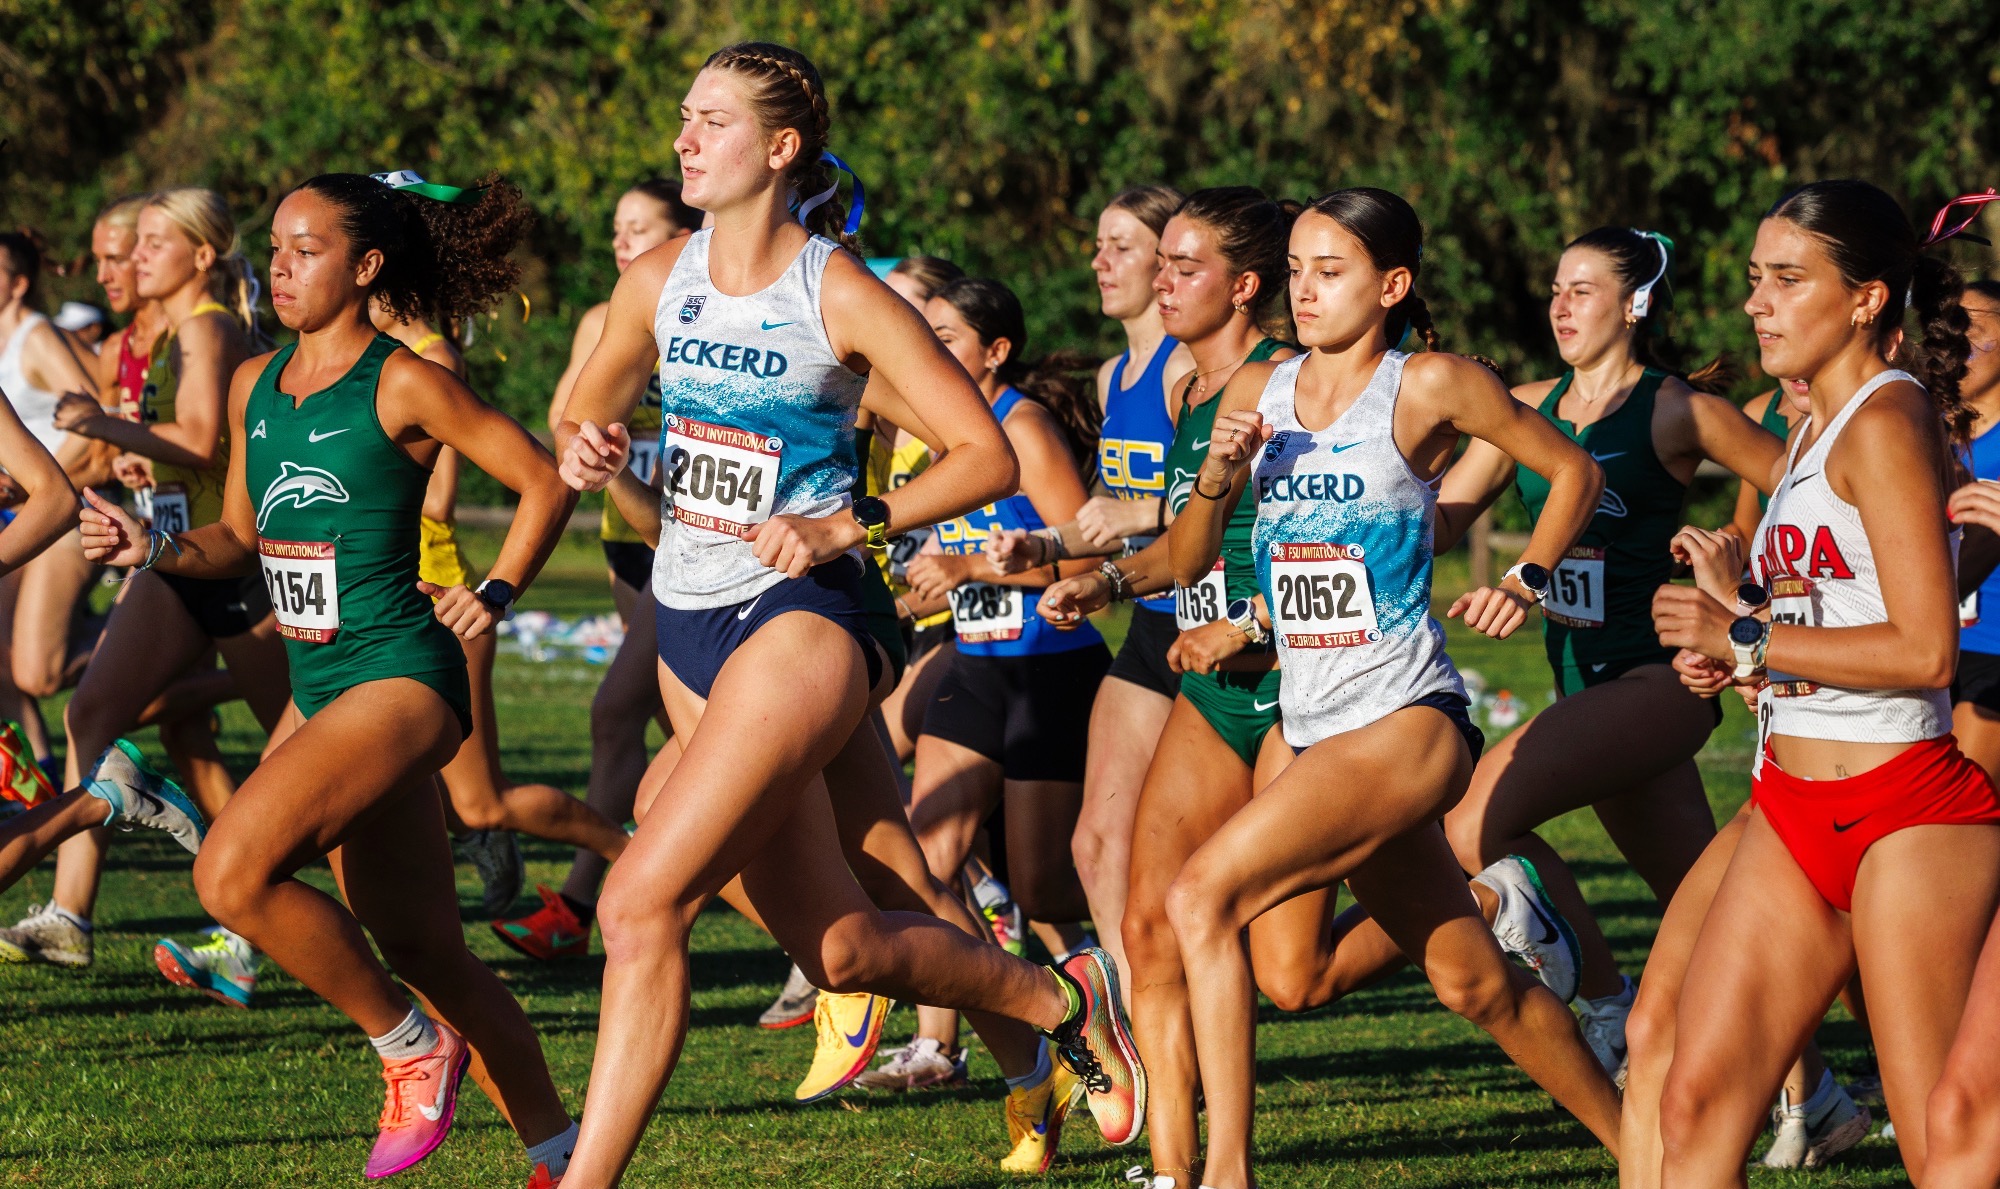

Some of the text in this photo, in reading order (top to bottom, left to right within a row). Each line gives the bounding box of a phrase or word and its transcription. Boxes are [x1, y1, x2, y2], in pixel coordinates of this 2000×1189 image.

[688, 297, 704, 305] SSC
[666, 337, 787, 379] ECKERD
[689, 423, 705, 437] FSU
[1098, 437, 1165, 490] SC
[671, 448, 762, 511] 2054
[1259, 473, 1365, 503] ECKERD
[676, 507, 748, 536] FLORIDA STATE
[264, 542, 324, 557] FSU INVITATIONAL
[1288, 546, 1300, 558] FSU
[265, 567, 326, 615] 2154
[1278, 573, 1362, 621] 2052
[1549, 568, 1591, 609] 151
[281, 624, 322, 640] ORIDA STATE
[1290, 632, 1360, 647] FLORIDA STATE
